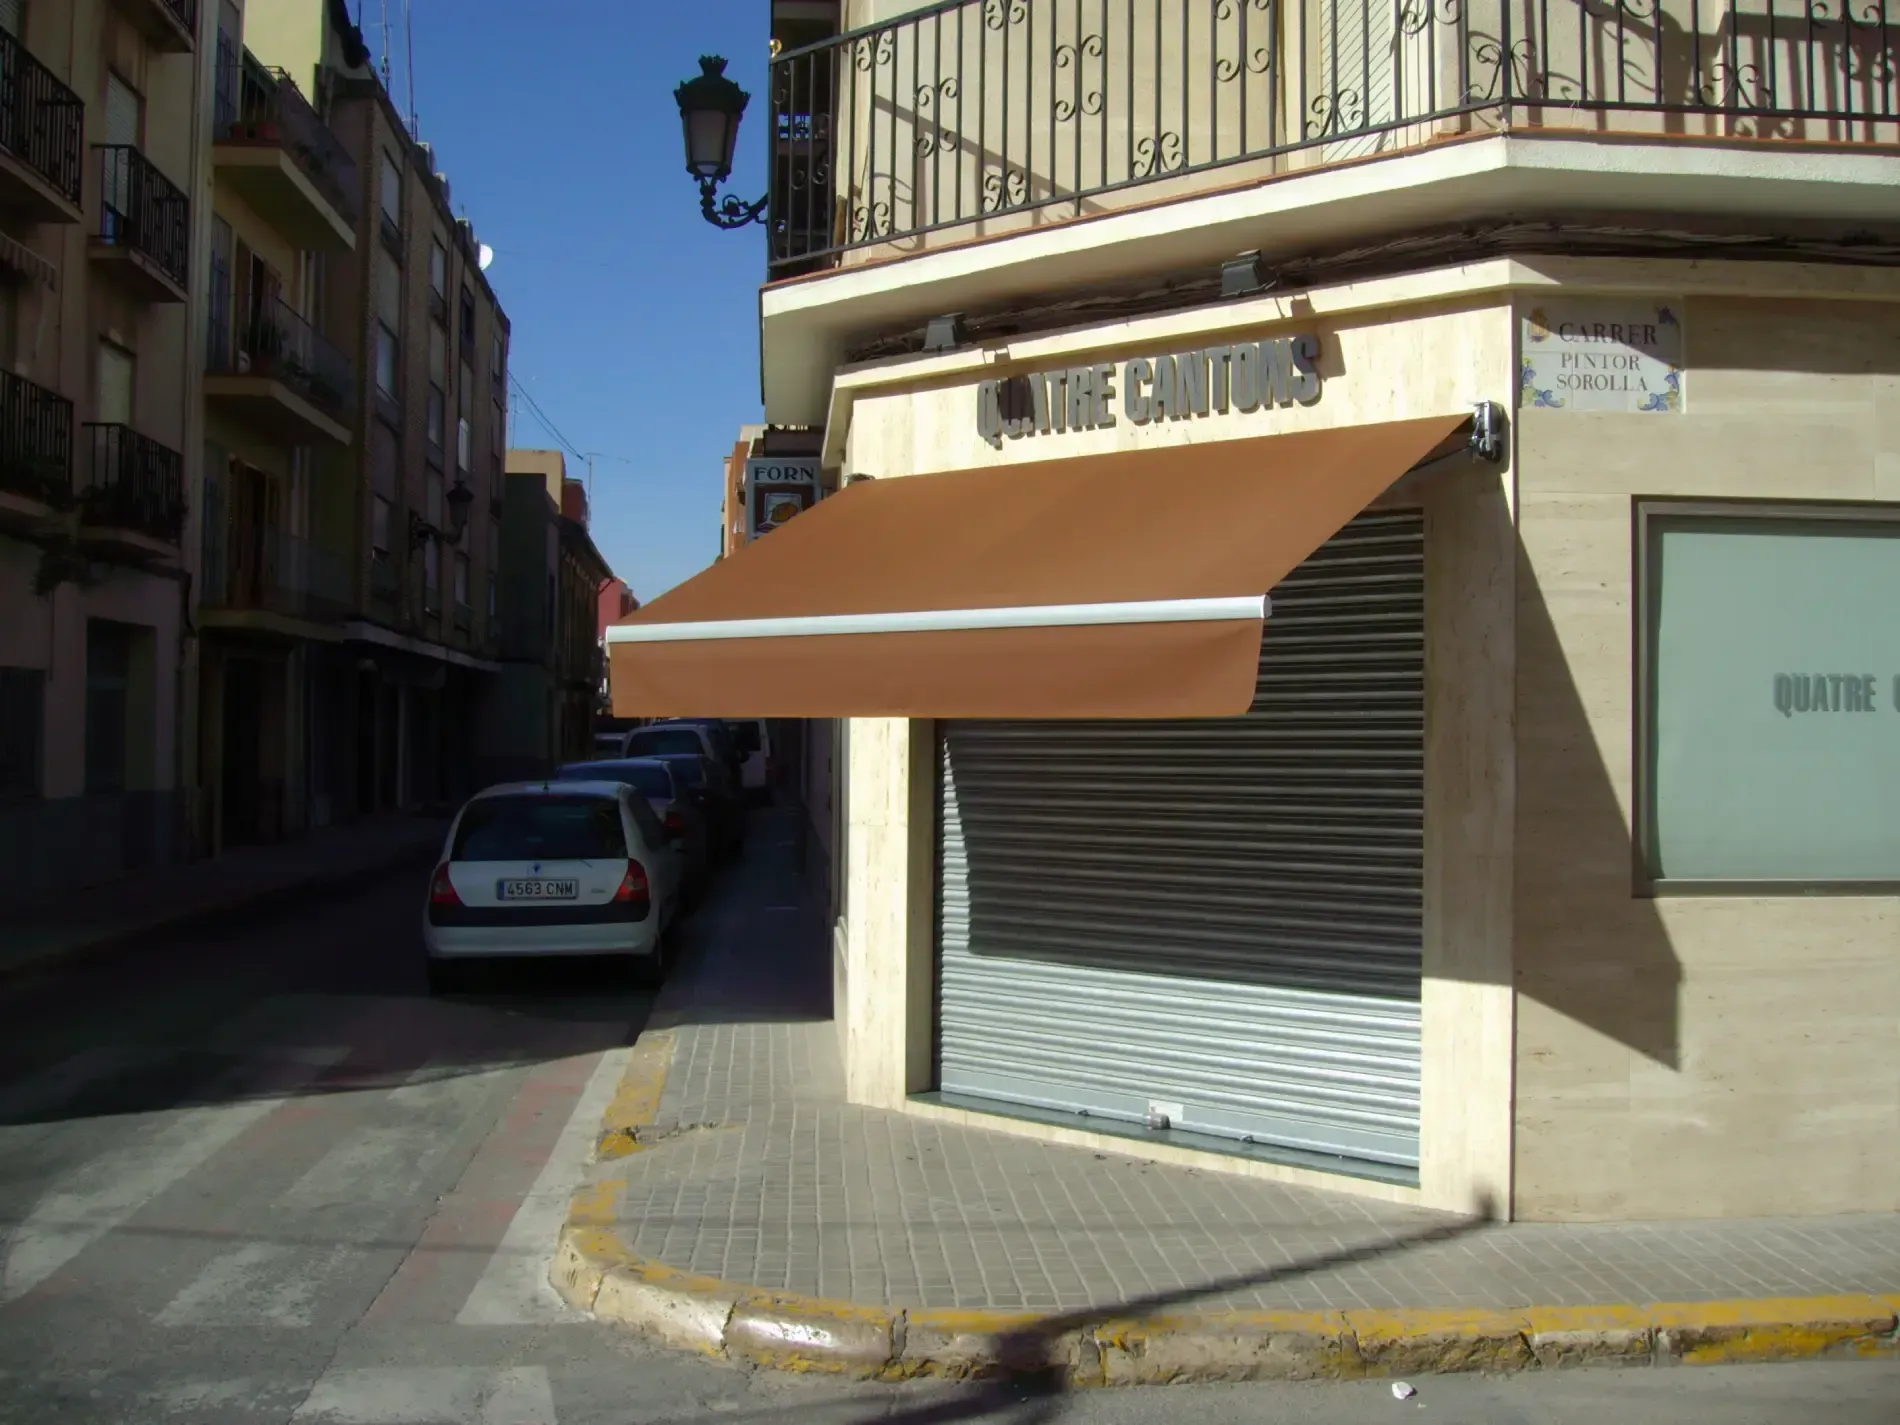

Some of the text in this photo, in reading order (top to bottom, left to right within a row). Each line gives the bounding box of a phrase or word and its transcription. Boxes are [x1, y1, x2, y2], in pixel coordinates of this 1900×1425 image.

[1559, 323, 1658, 345] CARRER
[1561, 352, 1640, 370] PINTOR
[1556, 374, 1648, 391] SOROLLA
[977, 335, 1322, 449] QUATRE CANTONS
[754, 466, 814, 480] FORN
[1773, 672, 1876, 719] QUATRE
[507, 881, 573, 895] 4563 CNM
